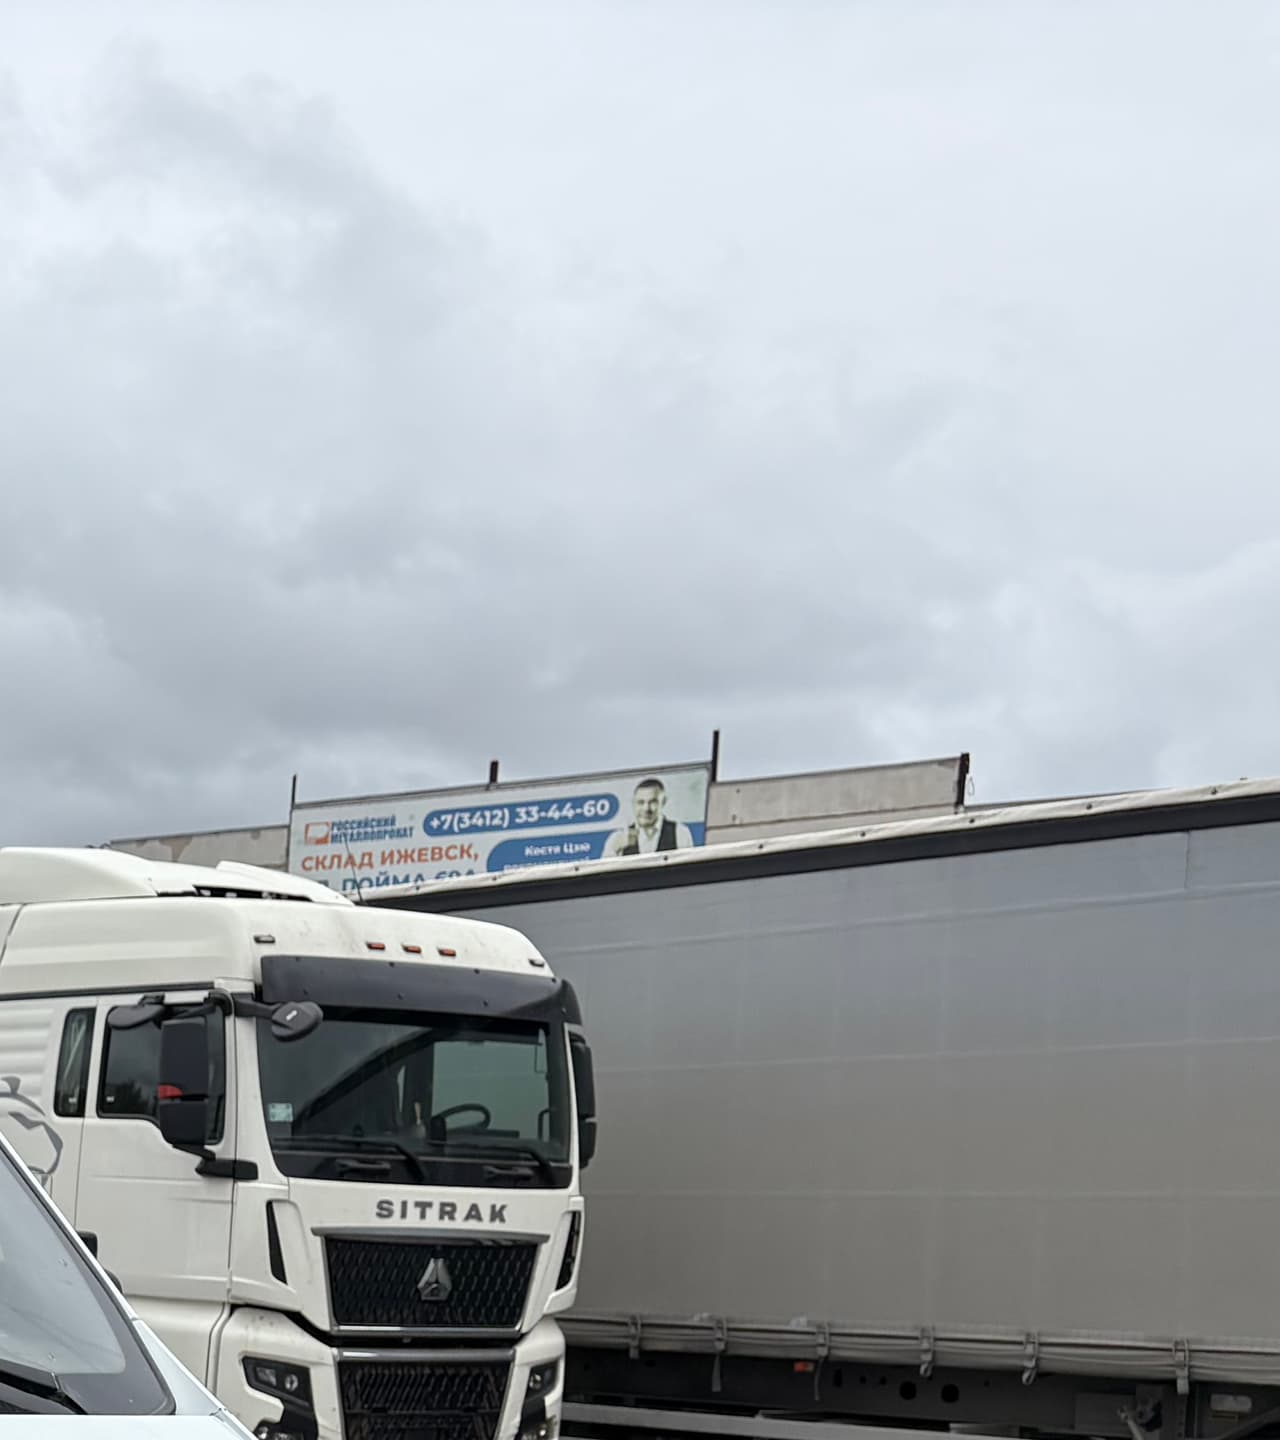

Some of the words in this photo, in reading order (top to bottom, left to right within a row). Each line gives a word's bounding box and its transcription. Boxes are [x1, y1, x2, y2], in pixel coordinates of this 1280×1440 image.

[430, 807, 510, 833] +7(3412)
[515, 799, 610, 824] 33-44-60
[301, 852, 374, 871] СКЛАД
[380, 844, 480, 866] ИЖЕВСК,
[375, 1200, 507, 1223] SITRAK
